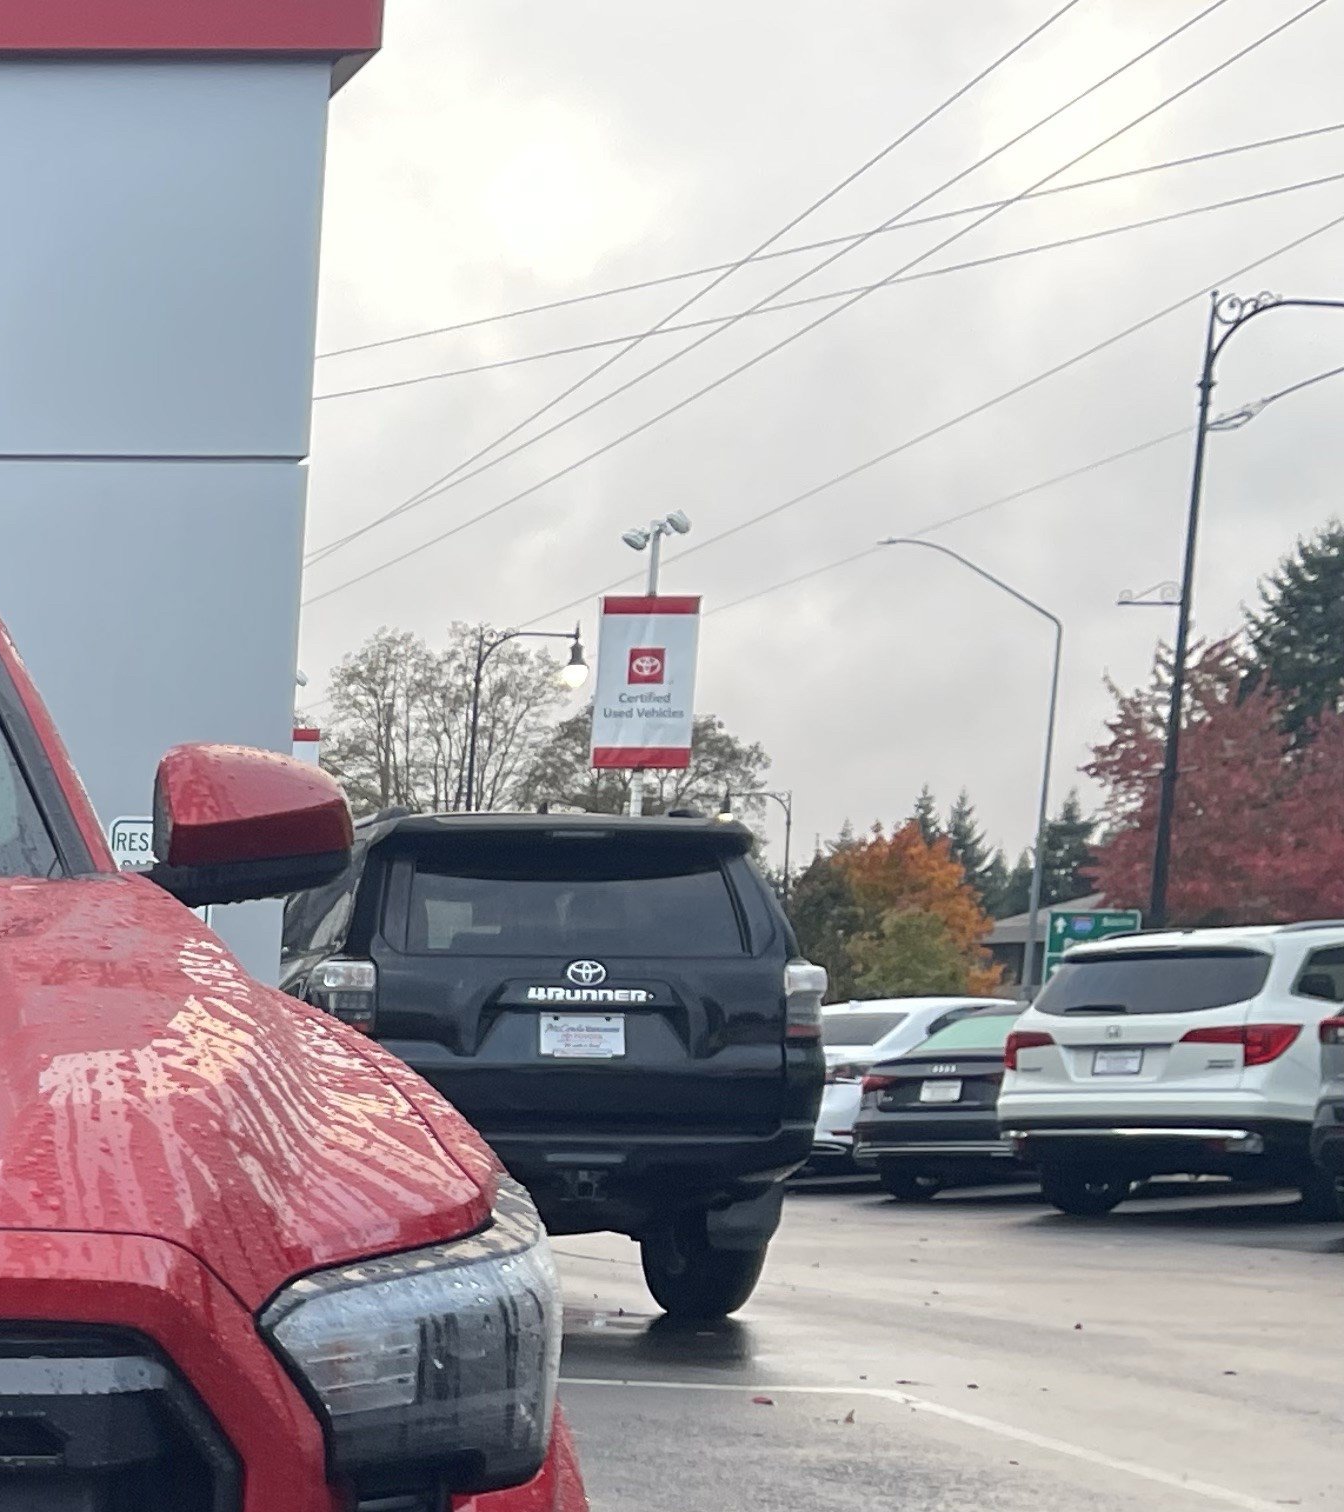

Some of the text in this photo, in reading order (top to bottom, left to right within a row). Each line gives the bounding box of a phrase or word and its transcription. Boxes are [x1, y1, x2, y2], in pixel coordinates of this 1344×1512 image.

[619, 692, 672, 704] Certified
[603, 708, 684, 718] Used Vehicles
[527, 986, 647, 1002] 4RUNNER
